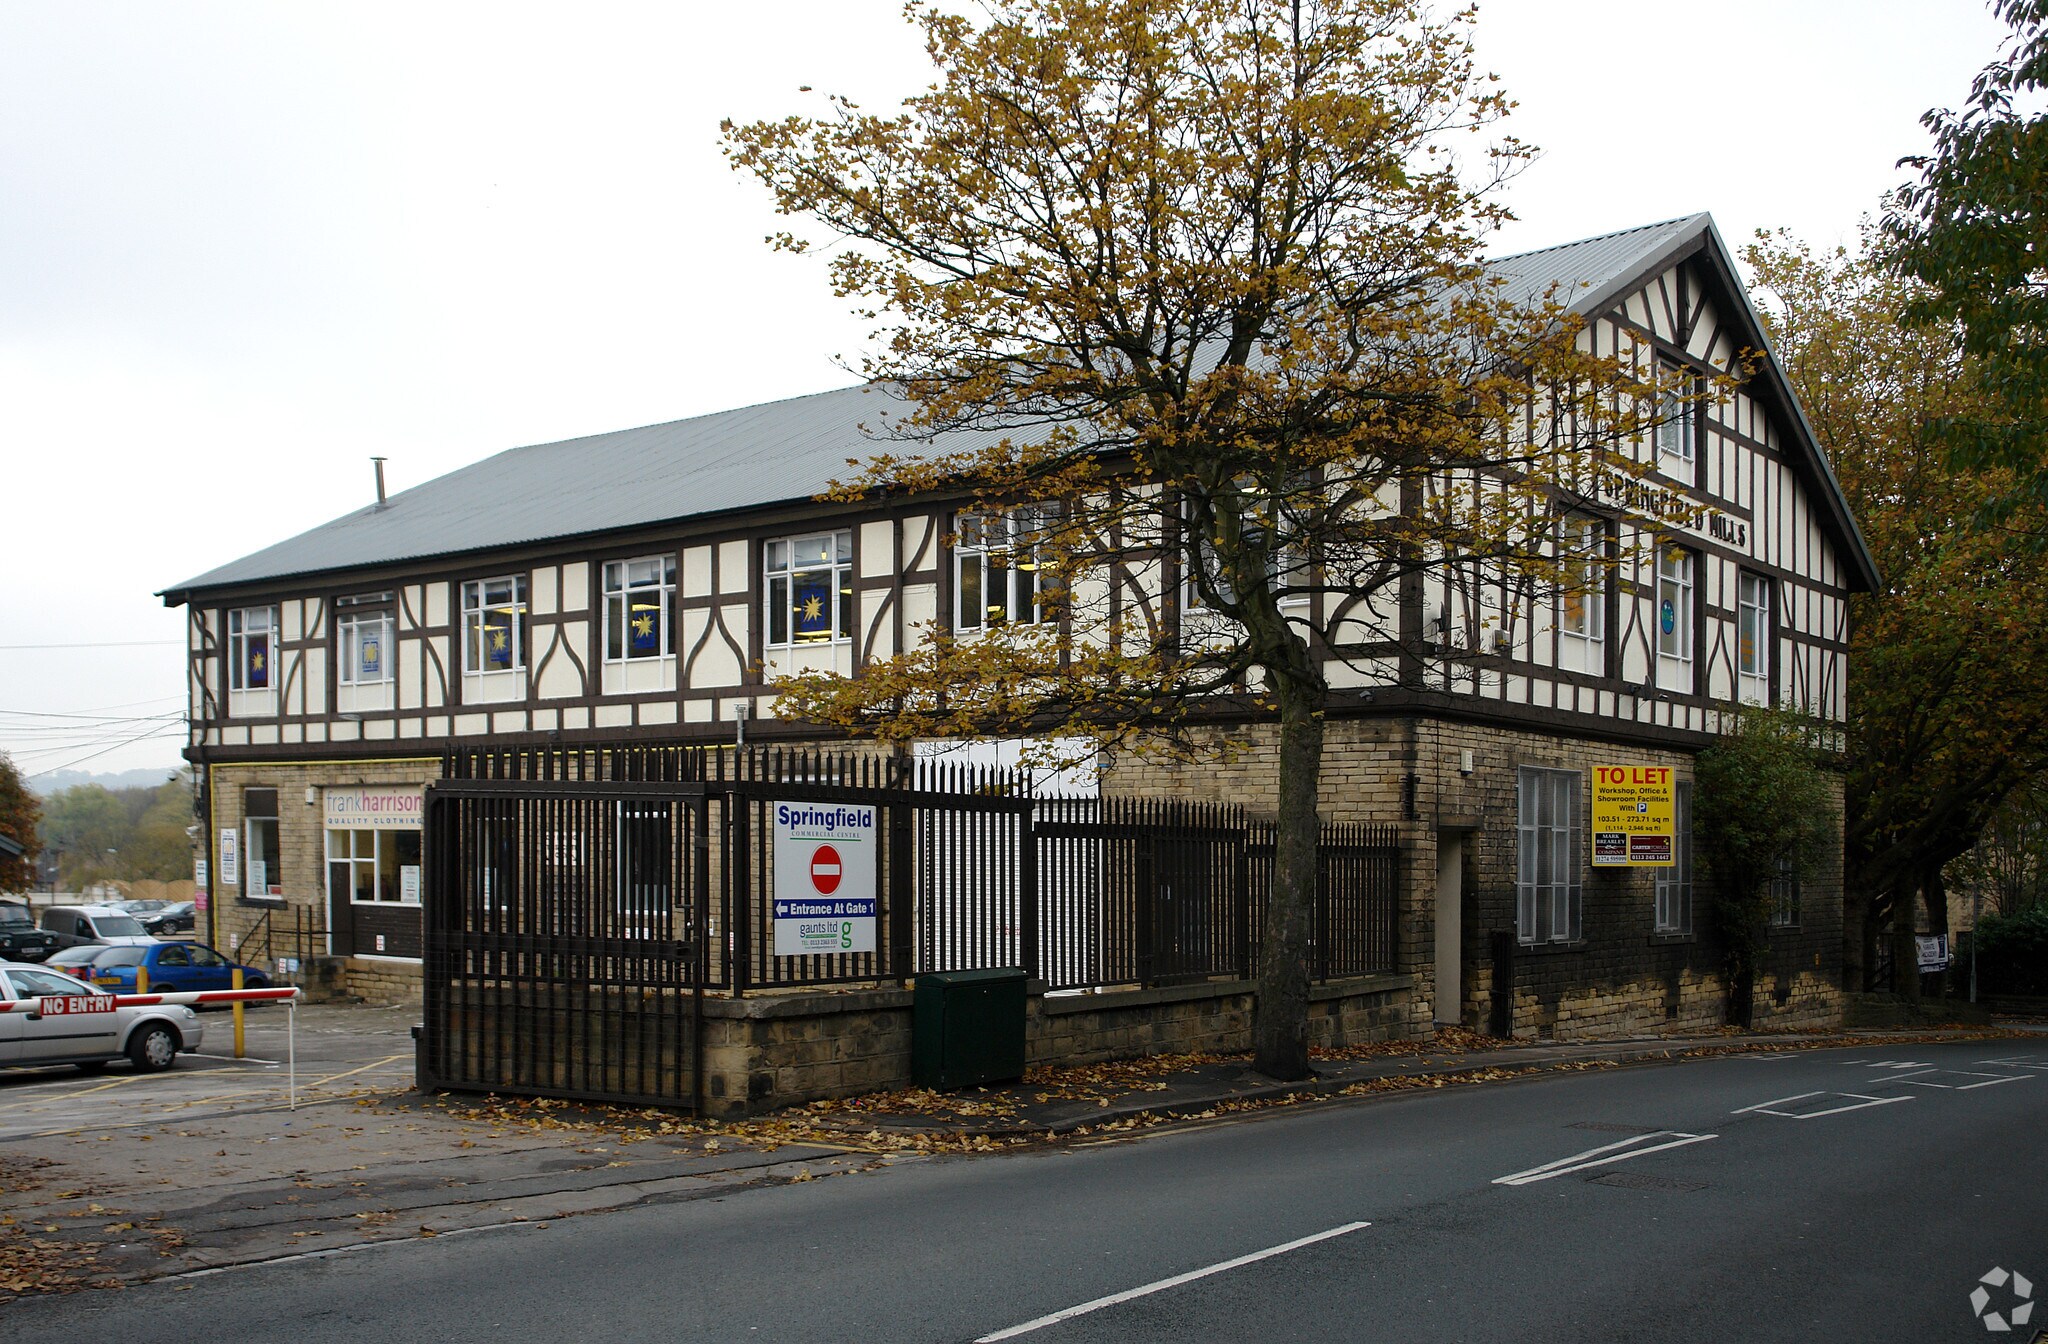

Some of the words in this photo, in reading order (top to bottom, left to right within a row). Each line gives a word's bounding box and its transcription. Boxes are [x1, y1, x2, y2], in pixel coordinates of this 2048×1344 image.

[1709, 513, 1745, 547] MILLS
[1597, 767, 1625, 784] TO
[1632, 767, 1670, 784] LET
[1598, 787, 1637, 795] Workshop,
[327, 788, 422, 812] frankharrison
[778, 805, 872, 831] Springfield
[1597, 815, 1620, 823] 103.51
[1626, 815, 1650, 823] 273.71
[791, 830, 834, 838] COMMERCIAL
[789, 903, 832, 915] Entrance
[834, 901, 844, 914] At
[846, 902, 868, 914] Gate
[869, 902, 874, 914] 1
[799, 922, 826, 938] gaunts
[827, 920, 838, 932] ltd
[43, 998, 64, 1014] NO
[69, 996, 114, 1013] ENTRY
